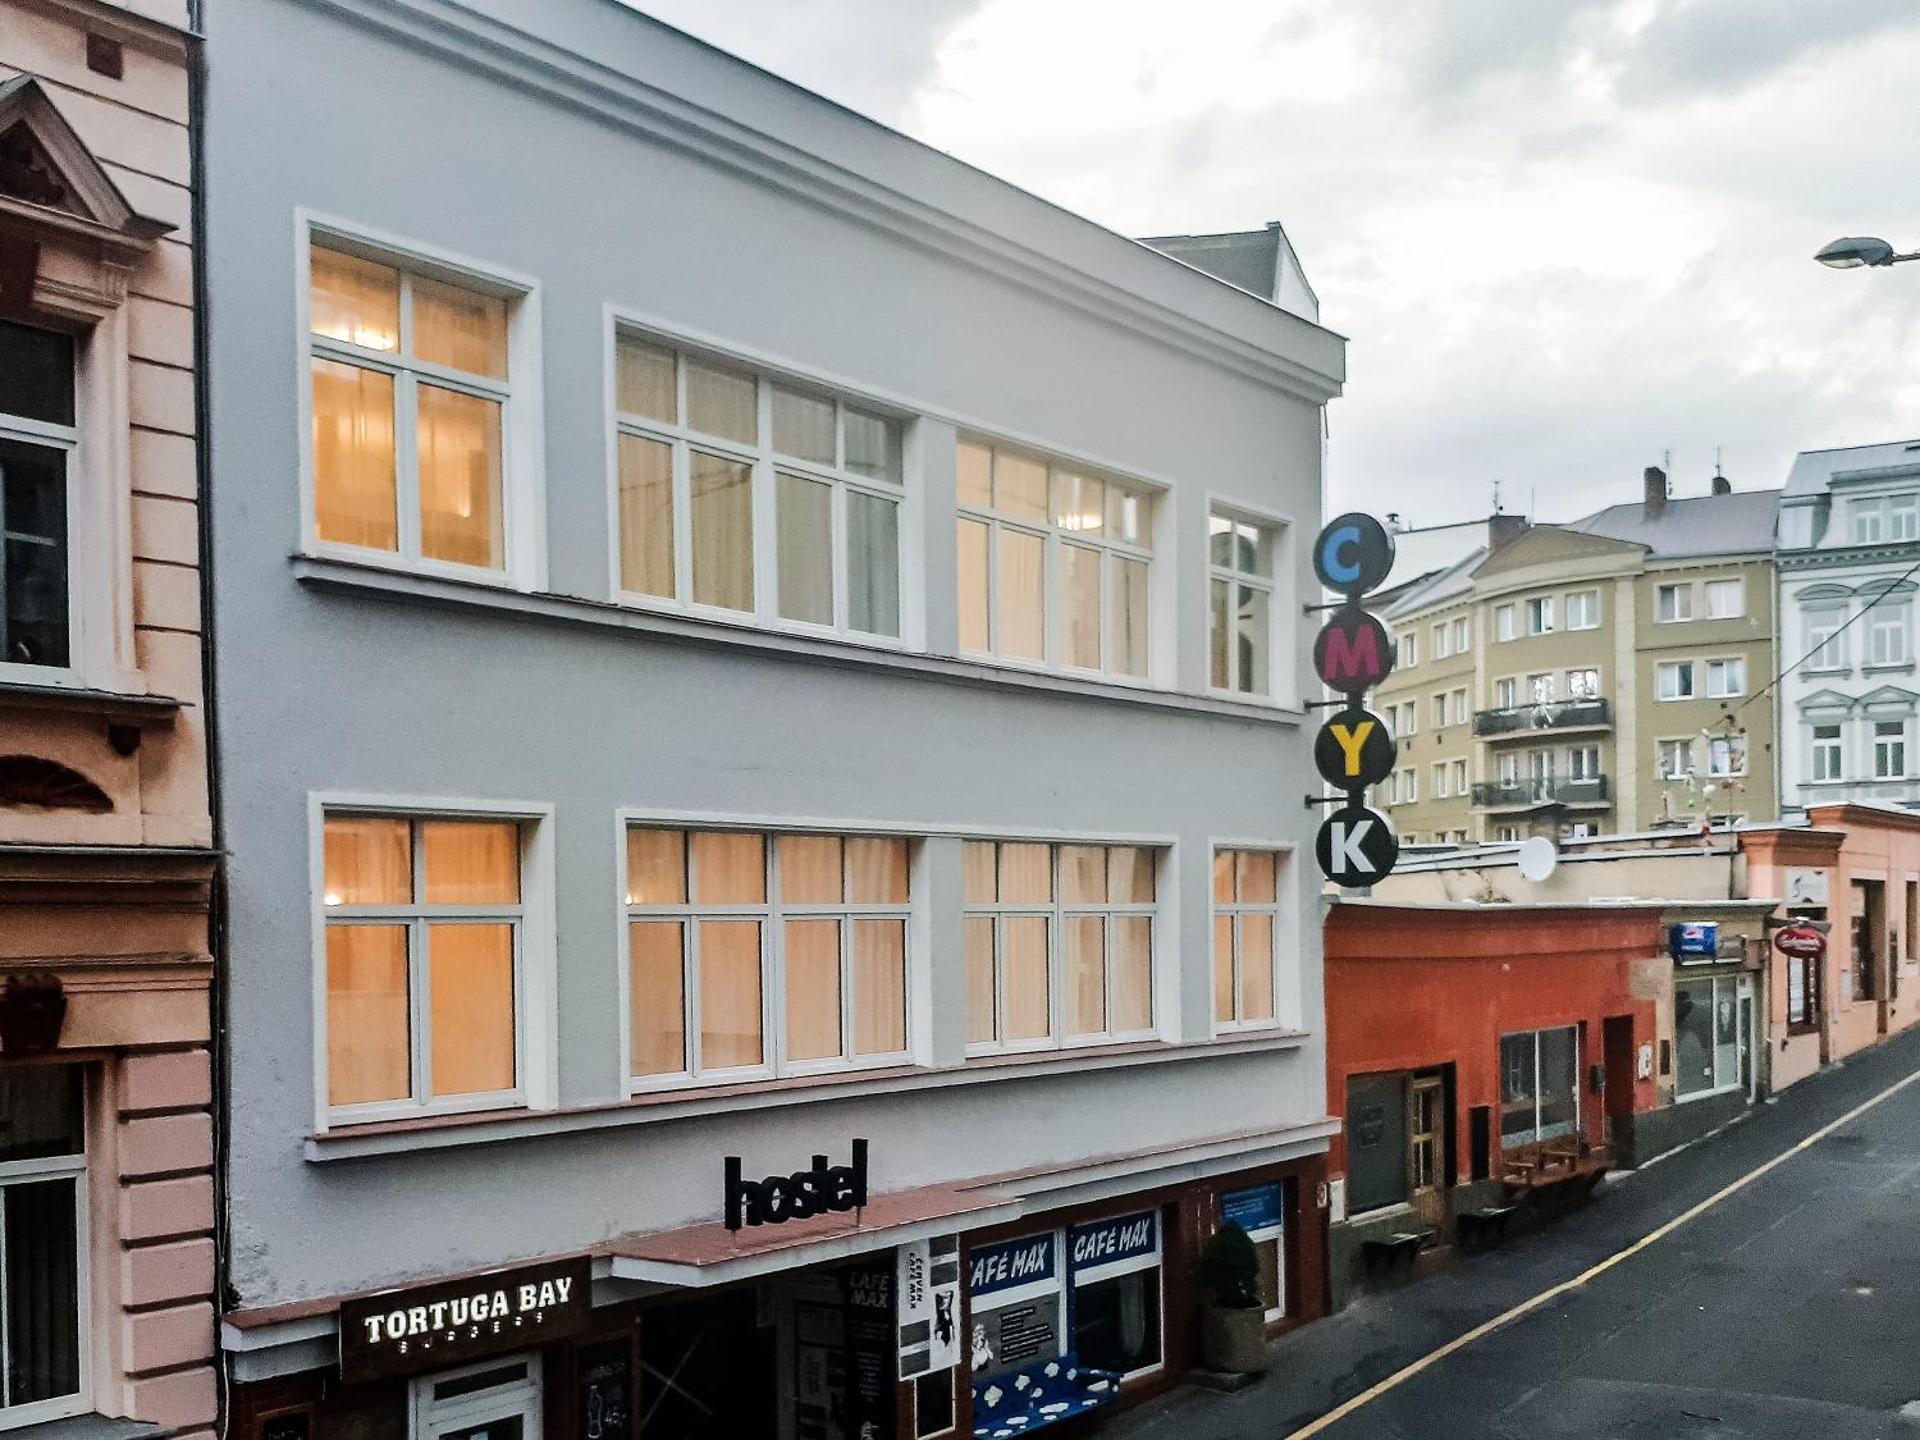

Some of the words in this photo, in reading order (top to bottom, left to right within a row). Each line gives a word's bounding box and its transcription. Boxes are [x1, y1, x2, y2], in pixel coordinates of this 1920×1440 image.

[724, 1138, 868, 1230] hostel
[1073, 1227, 1115, 1262] CAFÉ
[1119, 1219, 1150, 1252] MAX
[969, 1252, 1008, 1288] AFÉ
[1011, 1242, 1048, 1279] MAX
[364, 1290, 510, 1344] TORTUGA
[518, 1276, 573, 1312] BAY
[850, 1289, 889, 1309] MAX
